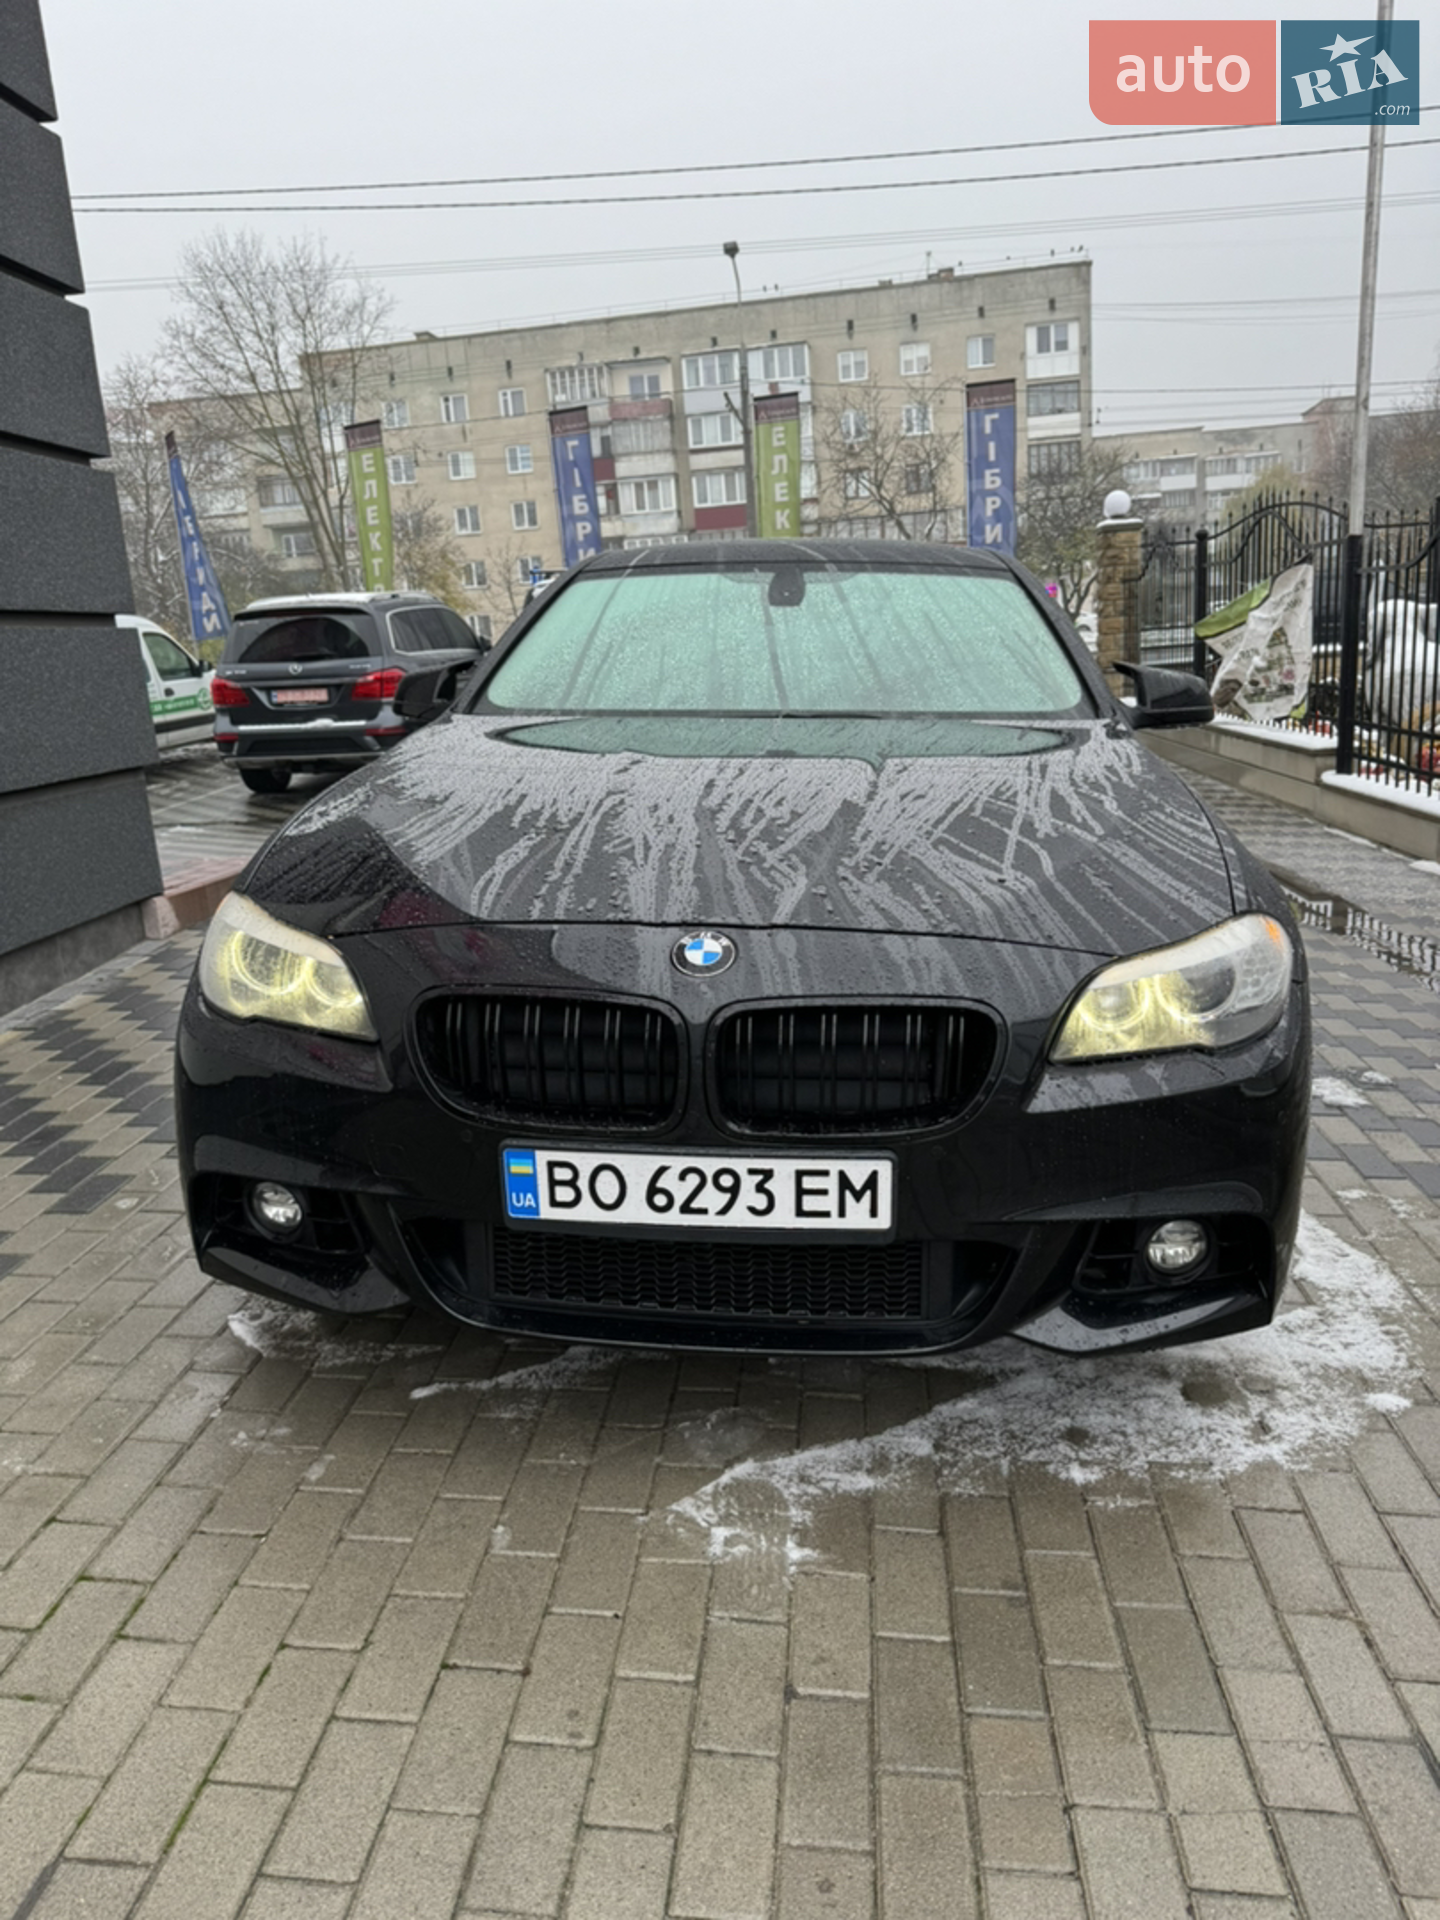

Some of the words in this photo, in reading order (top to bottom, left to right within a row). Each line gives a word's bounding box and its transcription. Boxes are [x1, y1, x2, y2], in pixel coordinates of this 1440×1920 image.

[770, 425, 791, 531] ЕЛЕК
[983, 412, 1003, 545] ГІБРИ
[511, 1191, 536, 1209] UA
[546, 1159, 628, 1212] BO
[645, 1164, 776, 1217] 6293
[794, 1168, 879, 1219] EM
